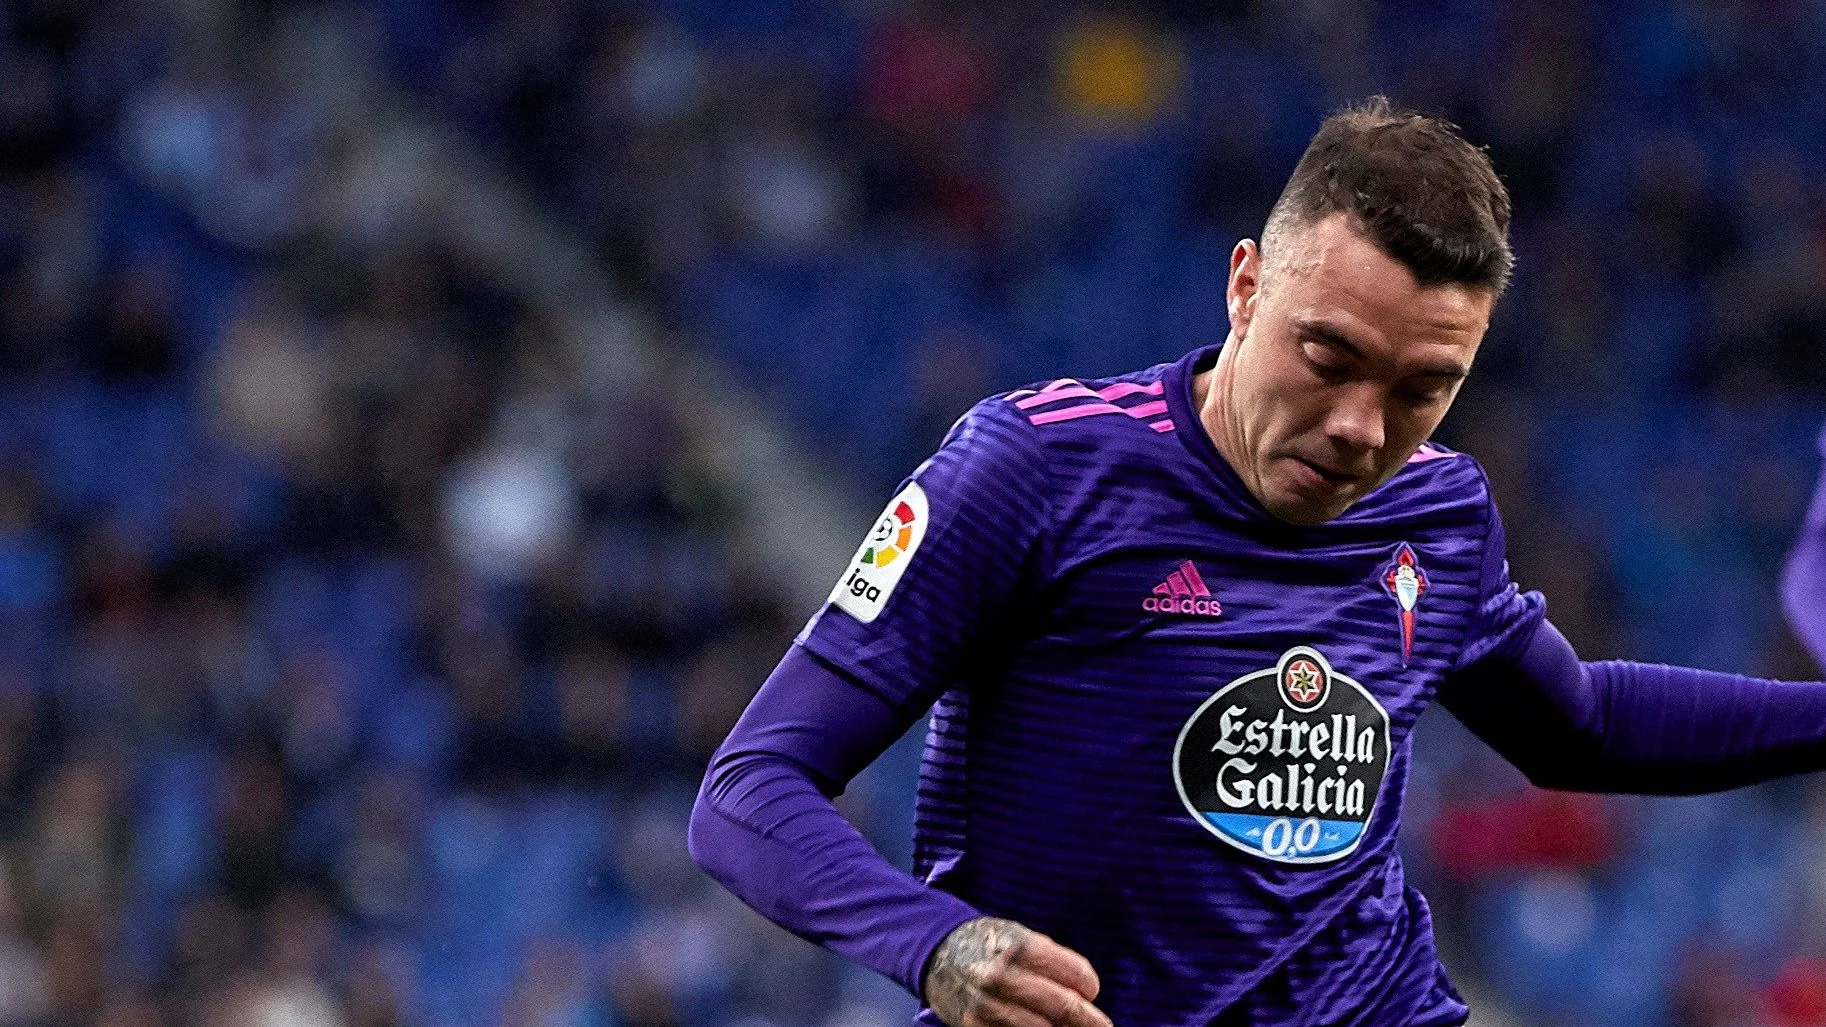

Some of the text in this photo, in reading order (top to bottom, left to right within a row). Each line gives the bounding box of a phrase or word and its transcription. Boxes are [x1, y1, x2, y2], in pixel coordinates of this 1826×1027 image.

[1142, 596, 1222, 616] adidas
[1211, 704, 1376, 764] Estrella
[1216, 757, 1365, 816] Galicia
